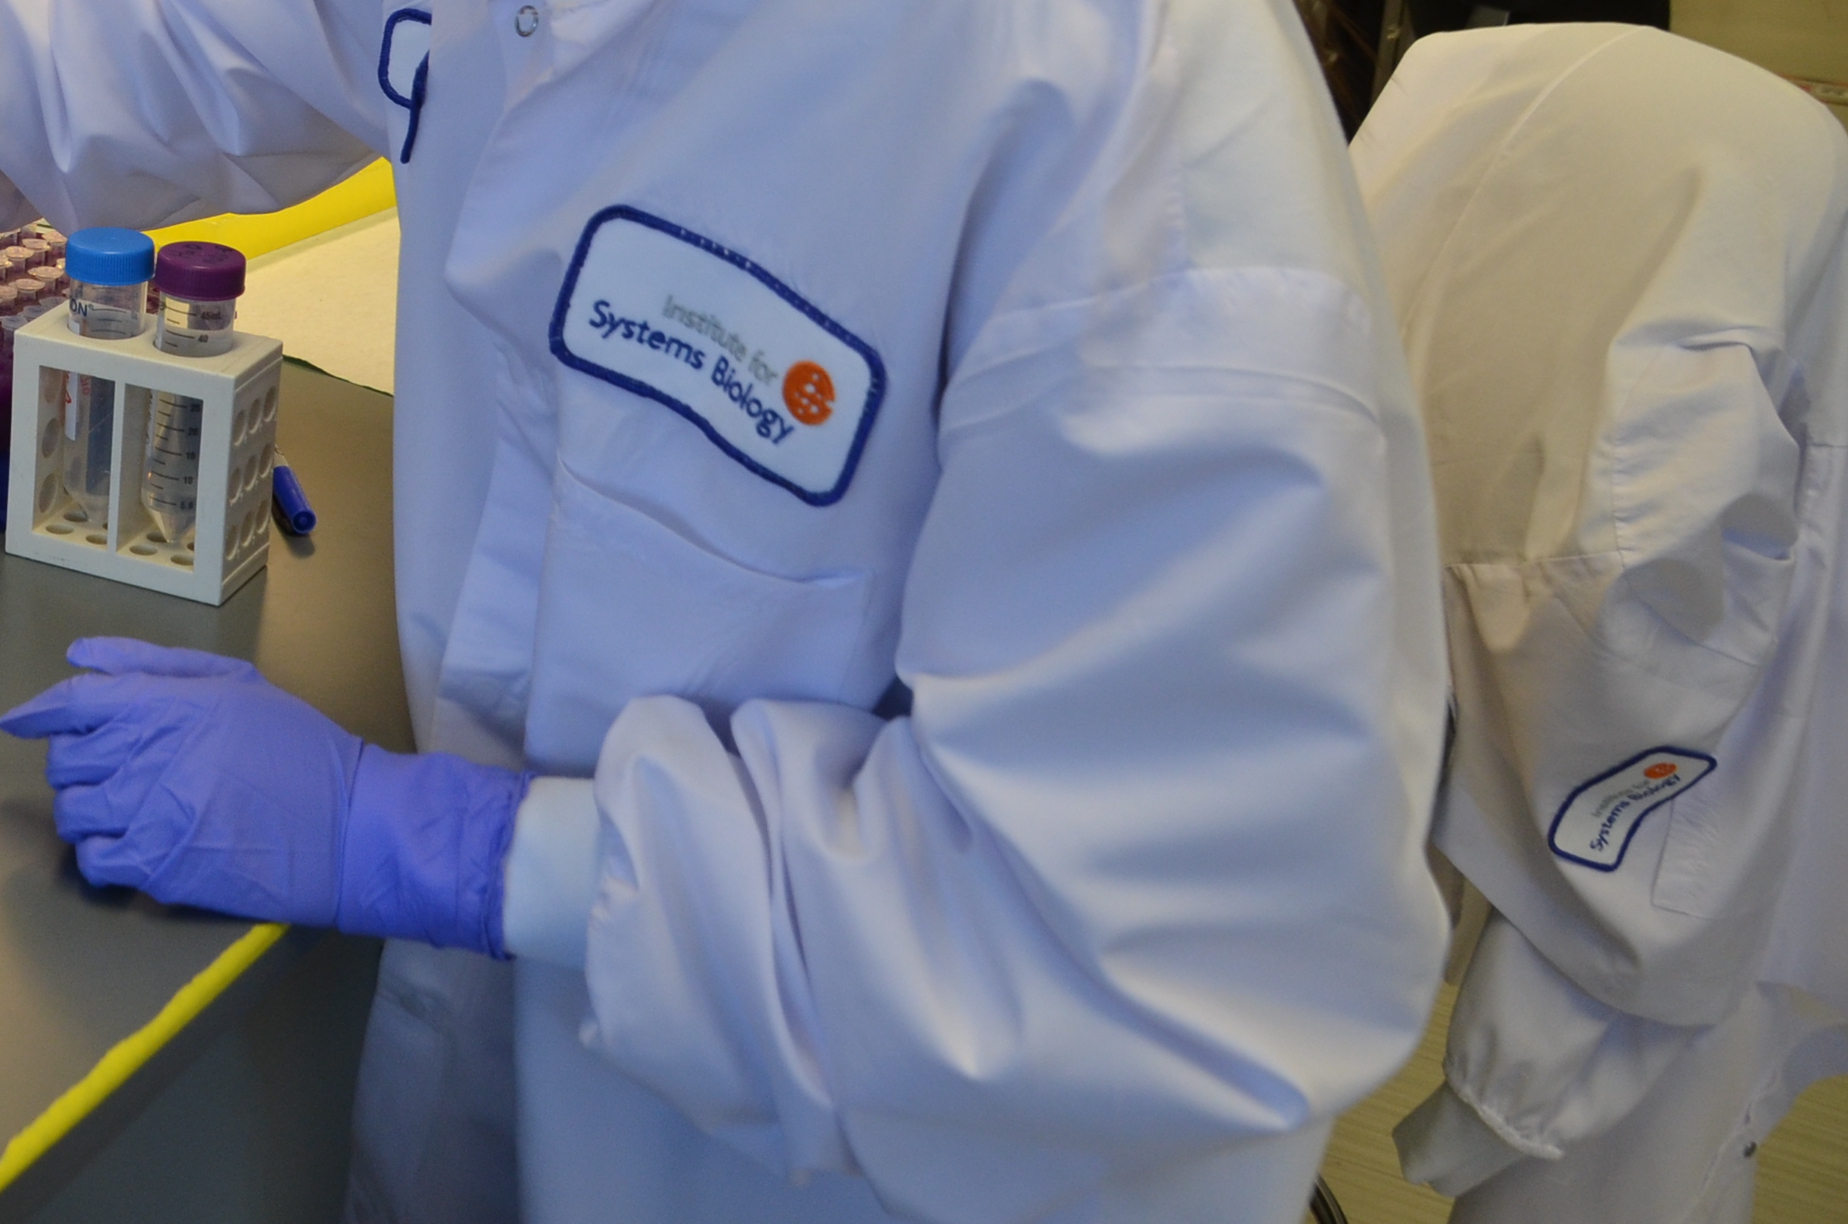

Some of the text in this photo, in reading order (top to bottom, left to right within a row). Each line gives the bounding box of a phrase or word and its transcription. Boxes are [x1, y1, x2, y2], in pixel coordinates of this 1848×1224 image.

[198, 332, 209, 344] 40
[589, 299, 796, 446] Systems Biology
[661, 294, 780, 388] Institute for
[183, 475, 194, 486] 10
[1589, 774, 1682, 853] Systems Biology
